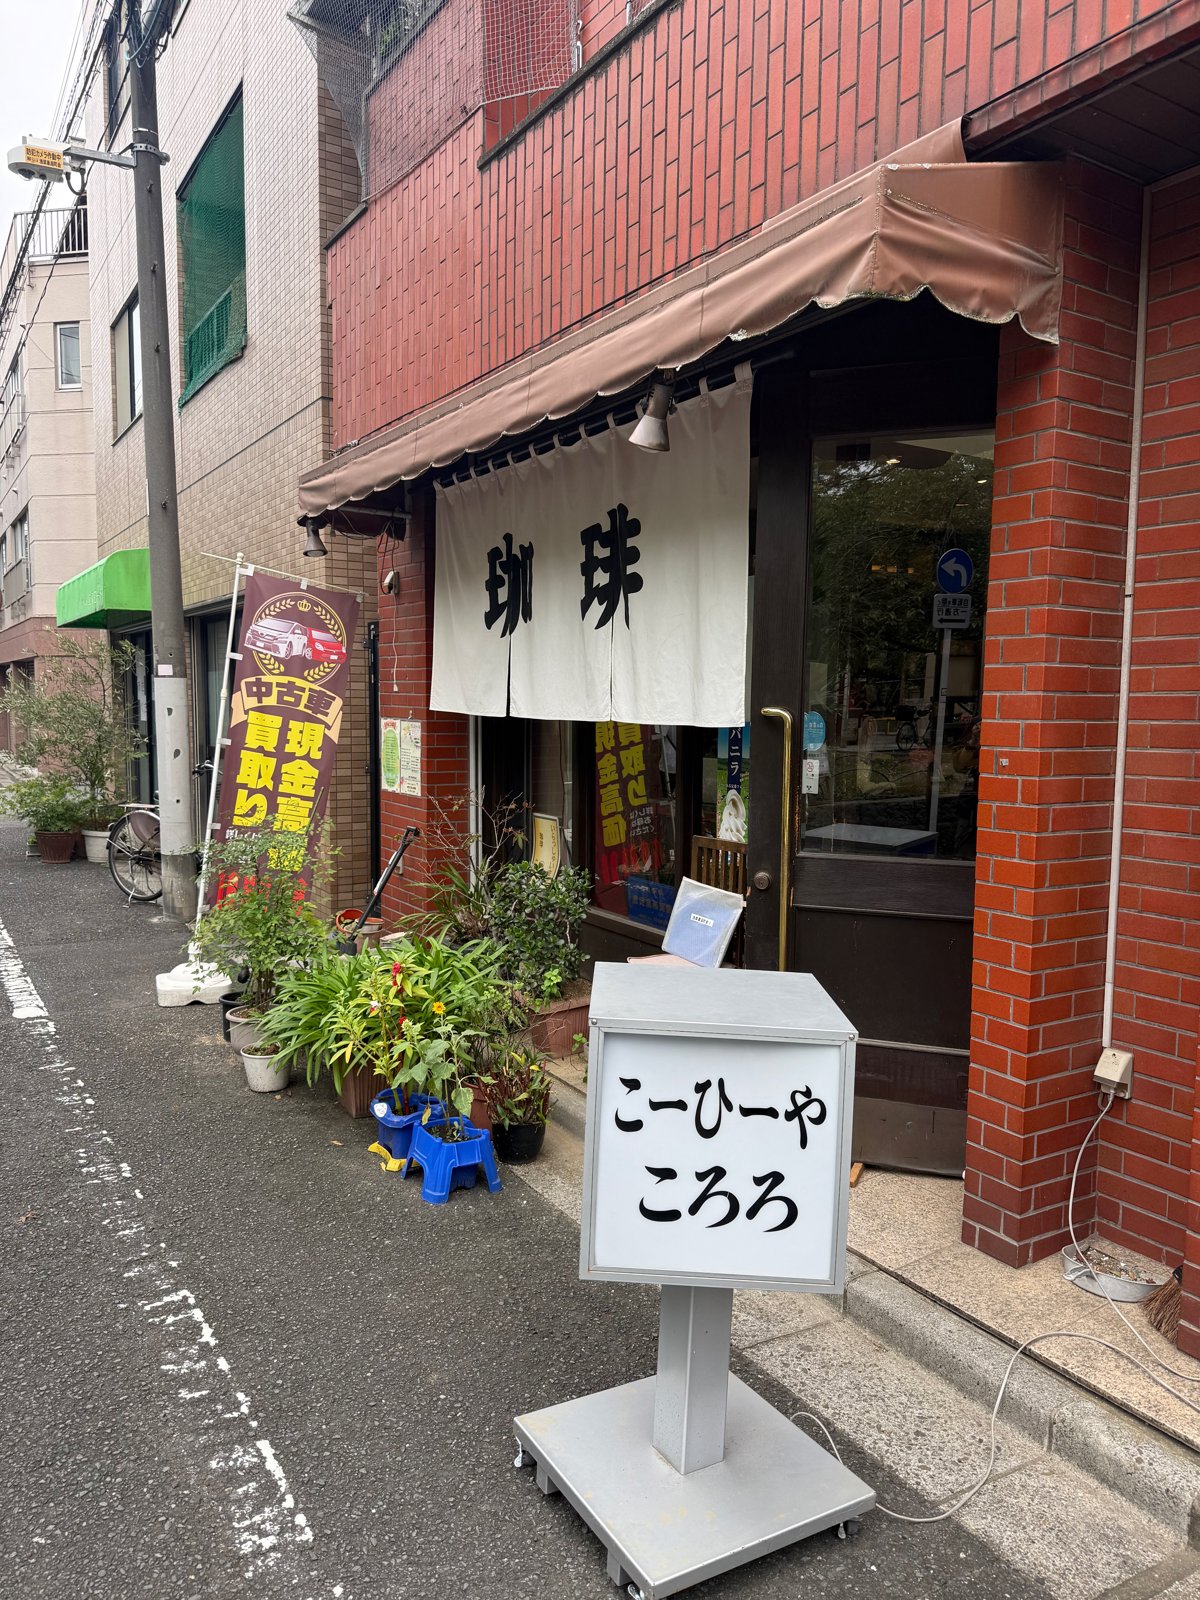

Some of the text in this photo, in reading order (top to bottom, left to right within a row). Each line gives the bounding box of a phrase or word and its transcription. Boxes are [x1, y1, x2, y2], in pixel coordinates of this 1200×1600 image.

[484, 502, 644, 639] 珈琲
[244, 677, 336, 717] 中古車
[232, 710, 283, 828] 買取り
[729, 727, 742, 776] バニラ
[614, 1076, 827, 1150] こーひーや
[638, 1165, 799, 1233] ころろ
